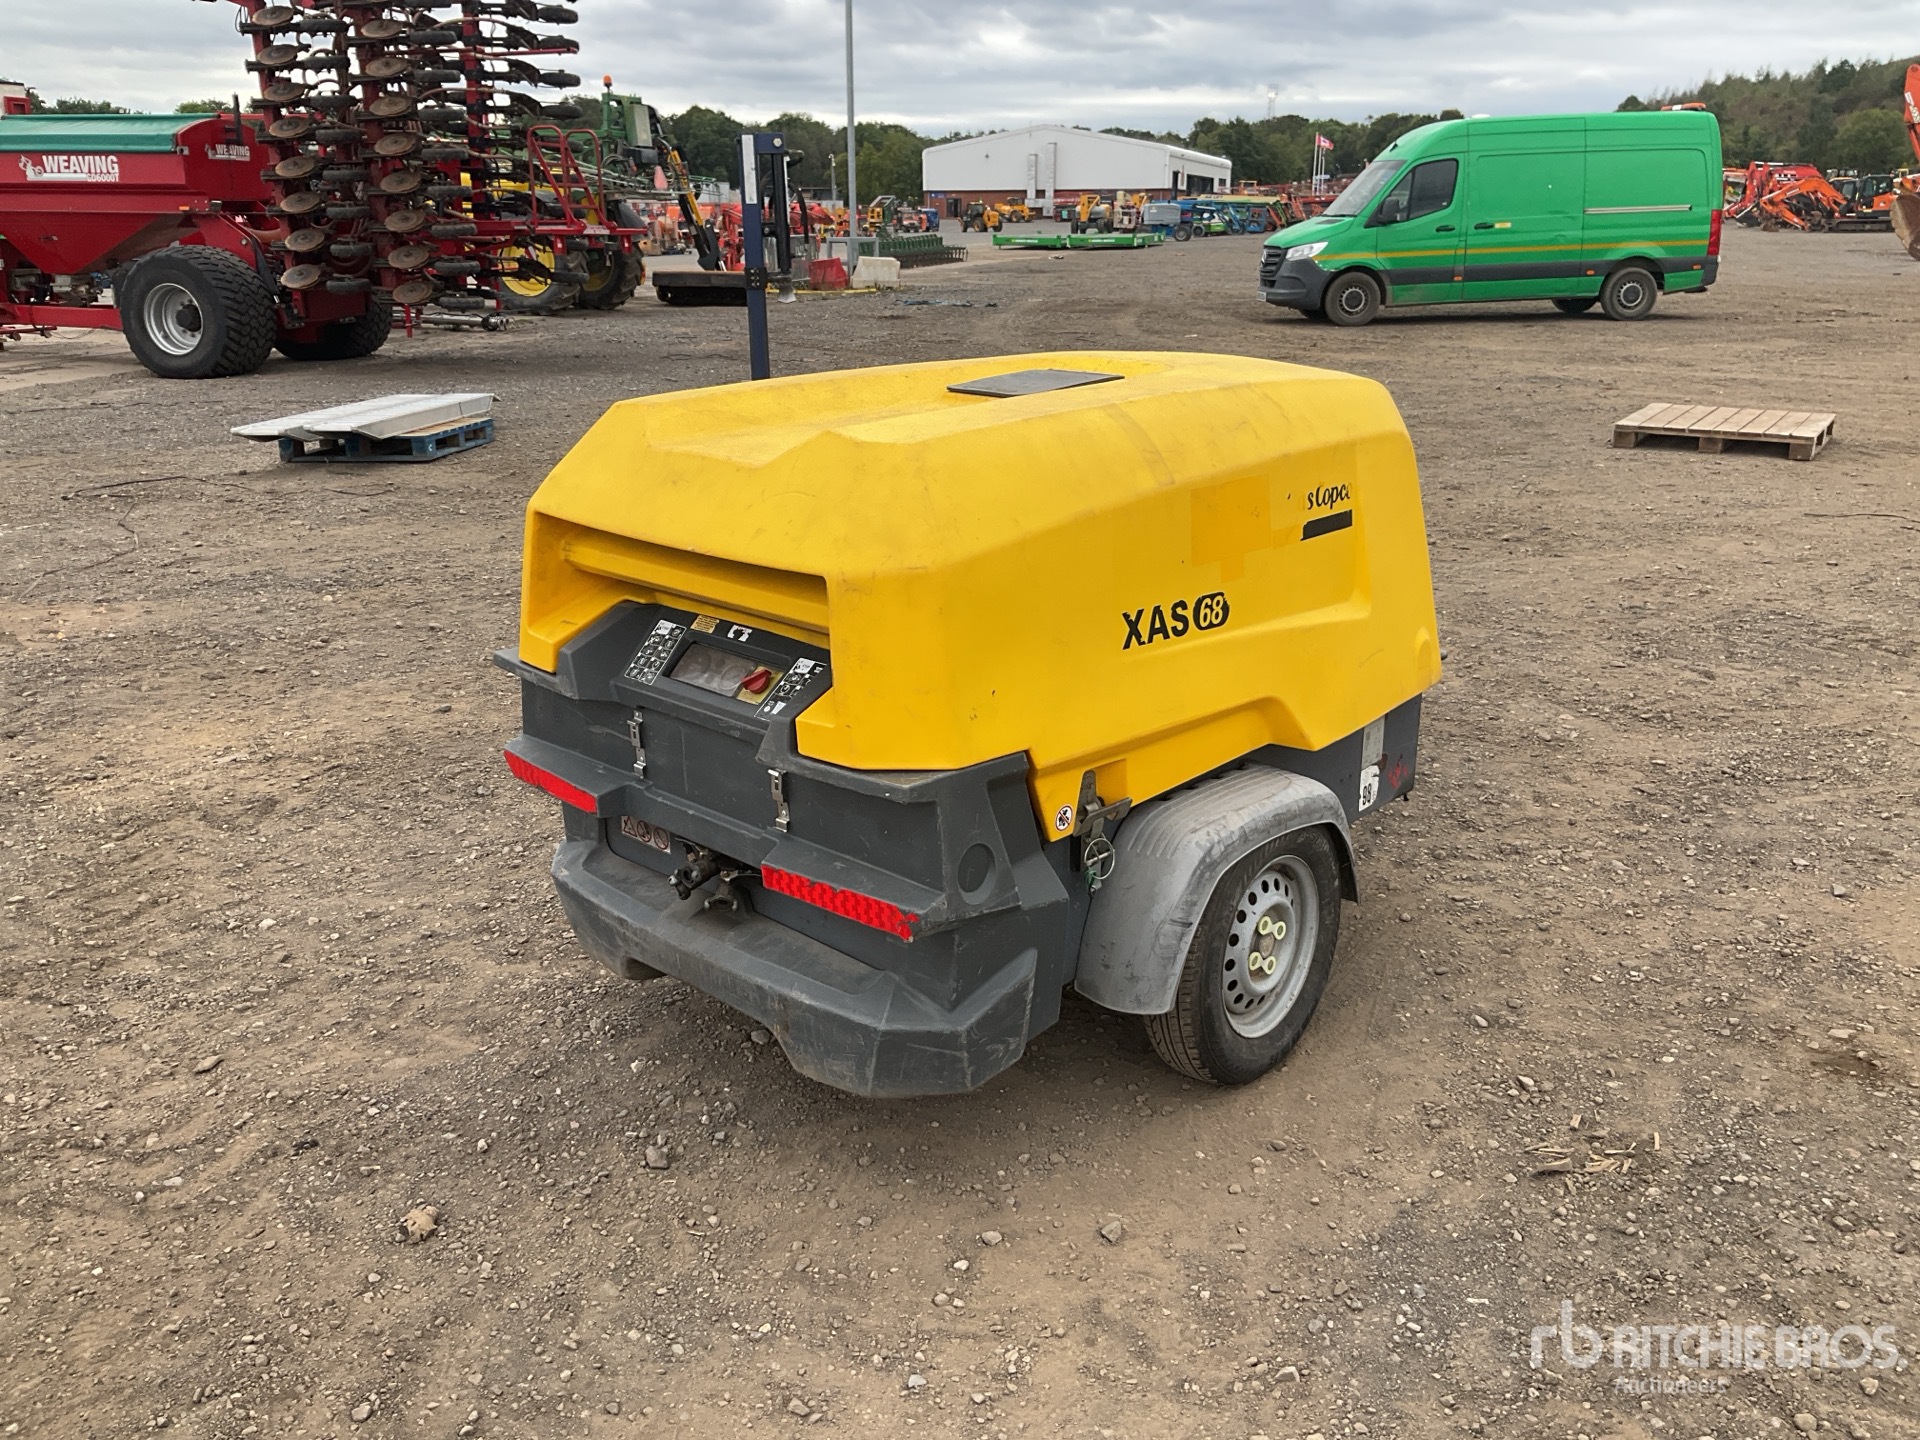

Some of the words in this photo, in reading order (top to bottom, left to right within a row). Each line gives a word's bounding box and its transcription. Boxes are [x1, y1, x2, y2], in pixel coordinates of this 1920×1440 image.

[42, 155, 119, 173] WEAVING
[1122, 600, 1190, 650] XAS
[1199, 594, 1226, 628] 68
